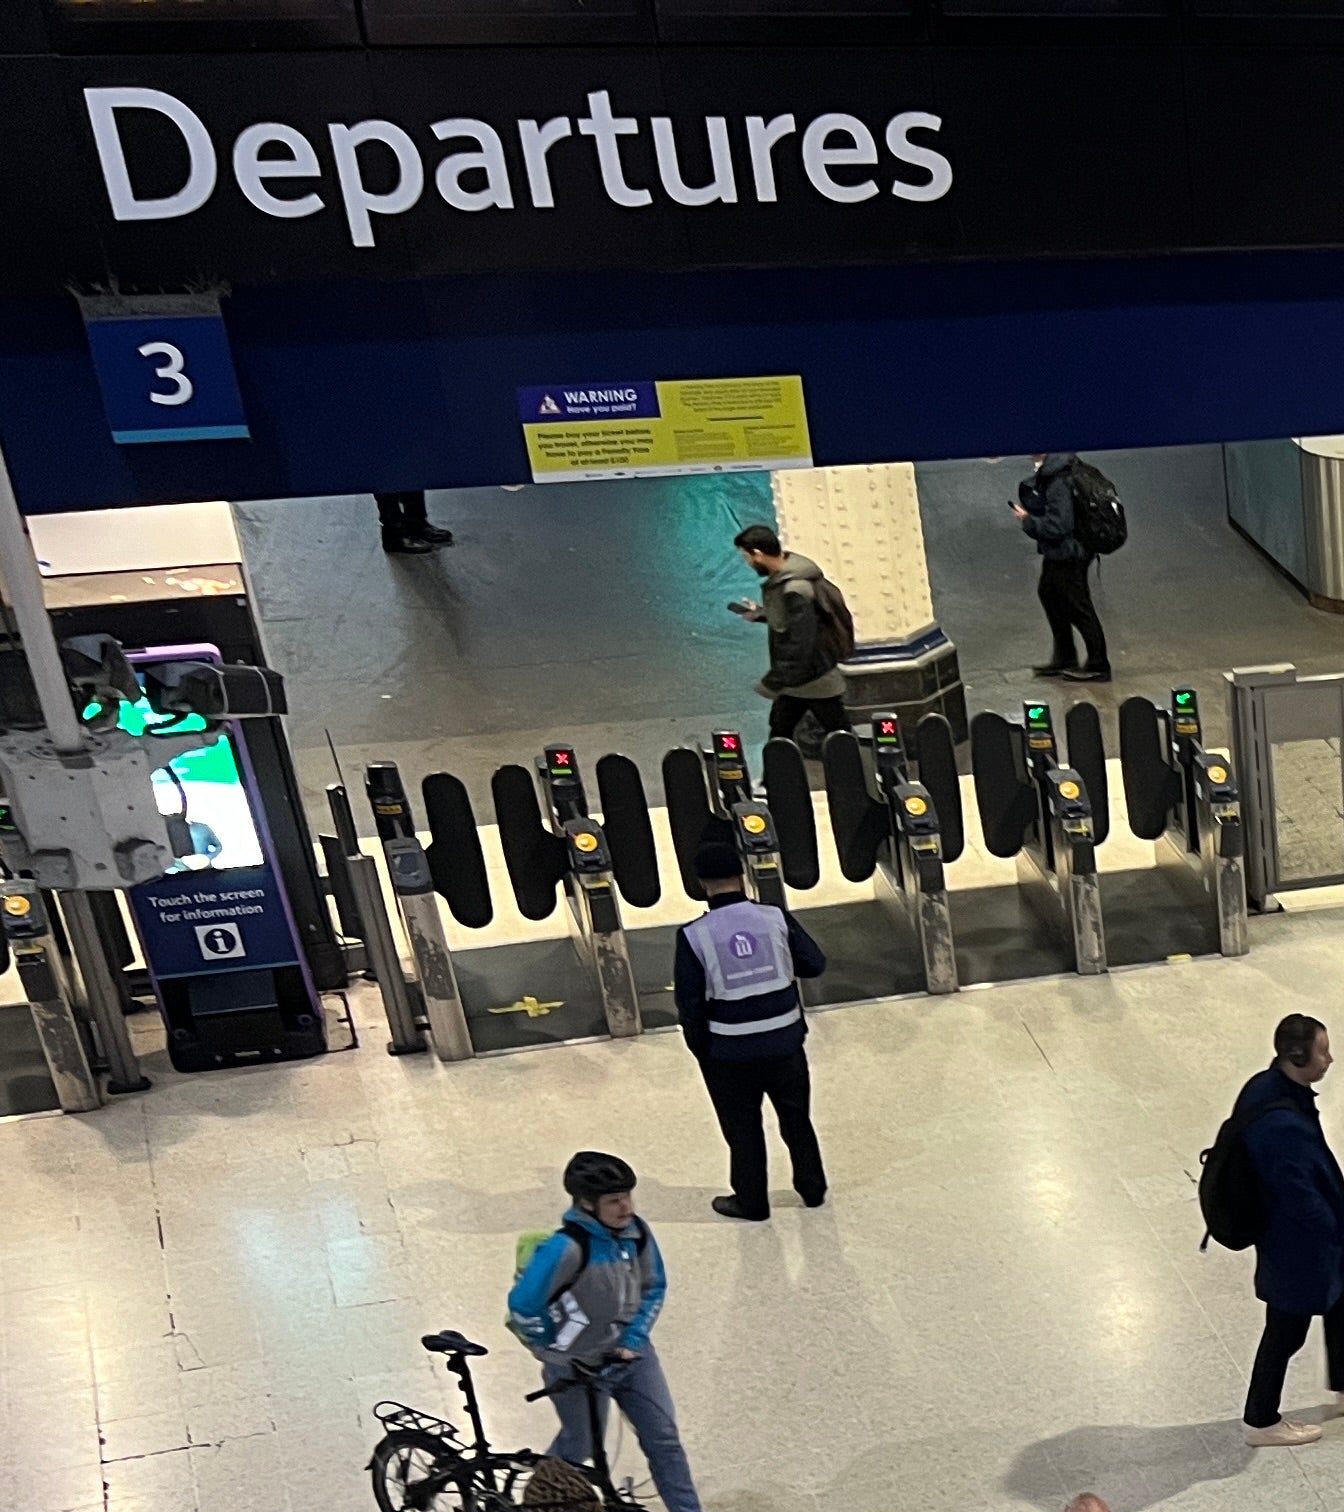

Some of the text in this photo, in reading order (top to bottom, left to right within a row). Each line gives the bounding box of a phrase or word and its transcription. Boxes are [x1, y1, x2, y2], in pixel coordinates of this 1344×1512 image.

[83, 87, 955, 248] Departures
[137, 341, 194, 406] 3
[563, 388, 638, 404] WARNING
[592, 405, 610, 415] you
[148, 888, 265, 908] Touch the screen
[160, 904, 264, 923] for information
